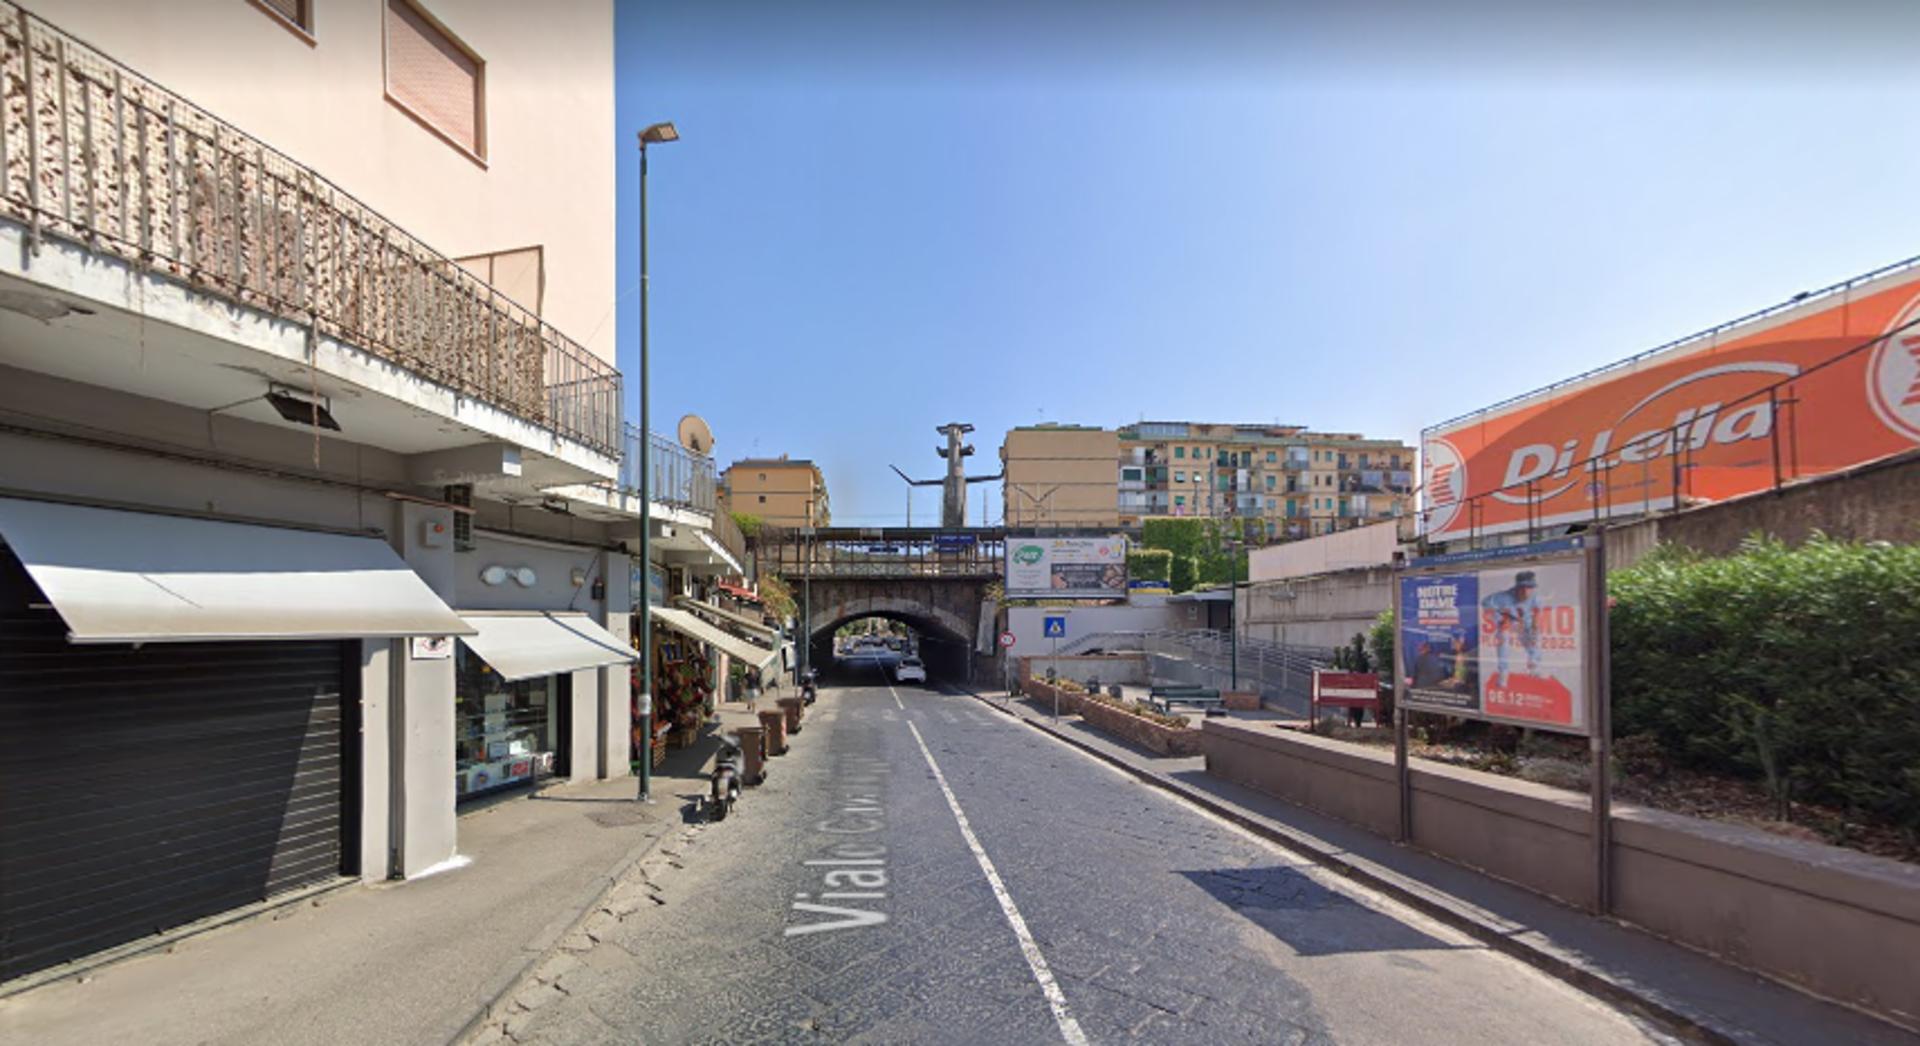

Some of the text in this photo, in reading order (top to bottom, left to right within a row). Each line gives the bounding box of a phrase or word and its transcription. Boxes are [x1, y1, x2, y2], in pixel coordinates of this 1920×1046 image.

[1502, 401, 1773, 489] Di Lella
[1417, 584, 1458, 598] NOTRE
[1418, 597, 1456, 609] DAME
